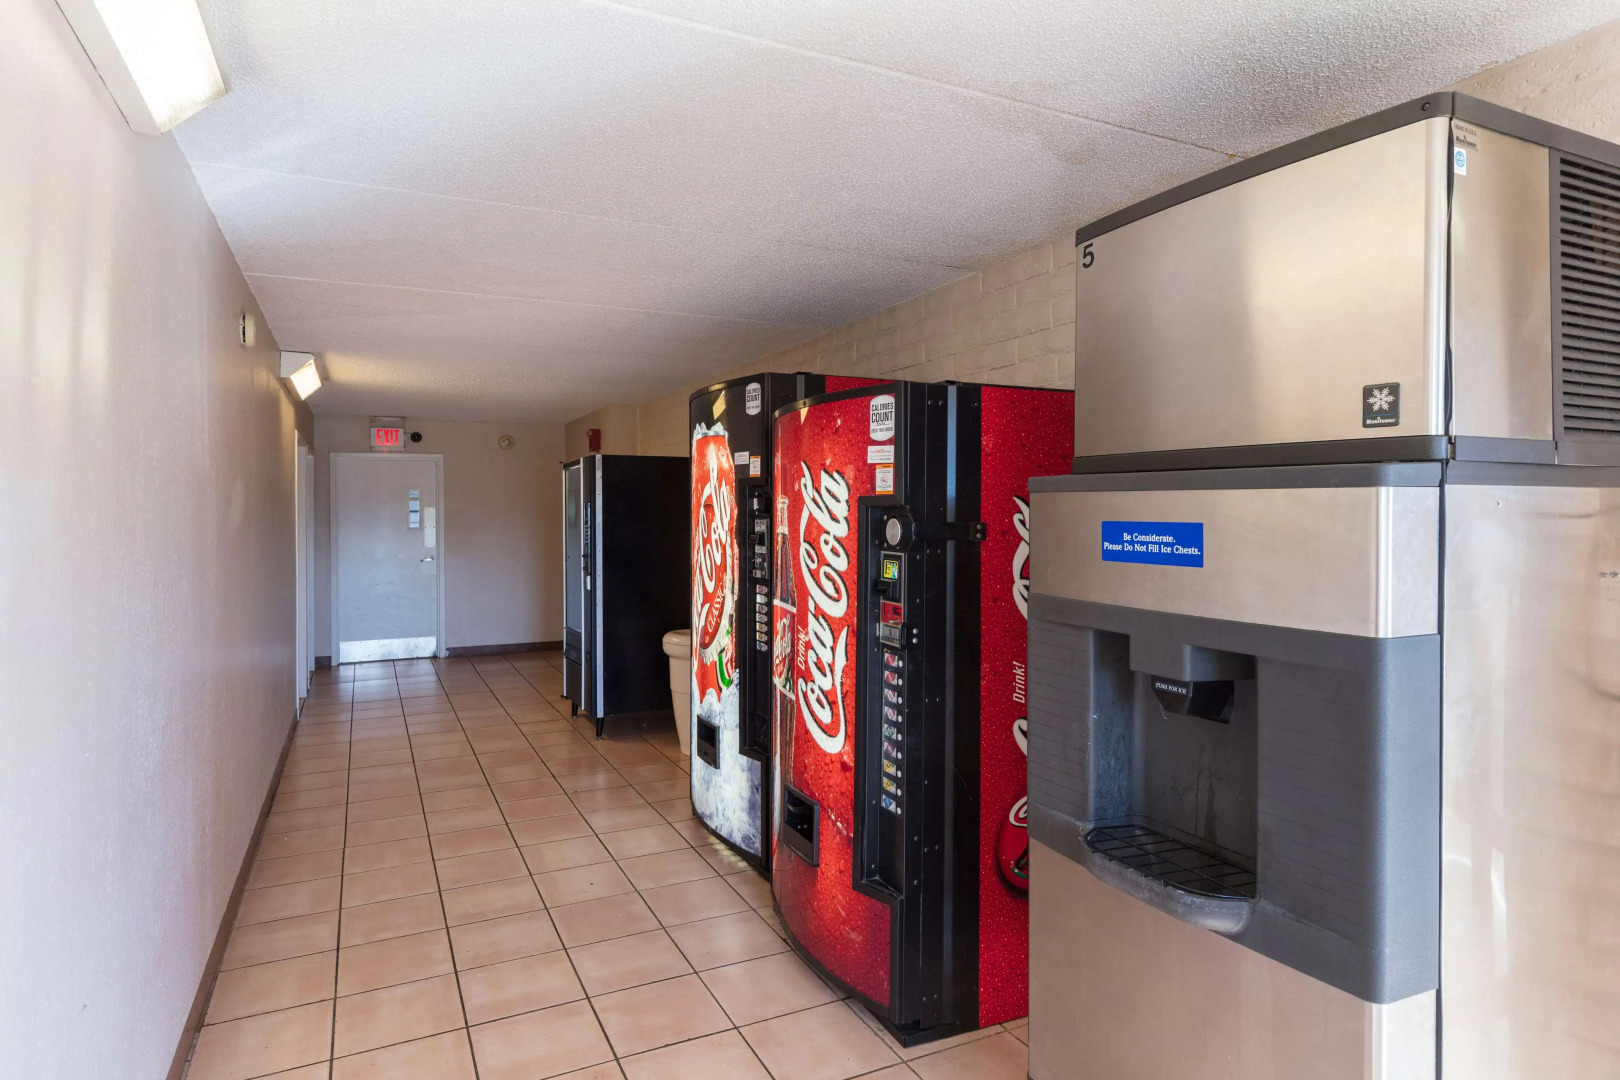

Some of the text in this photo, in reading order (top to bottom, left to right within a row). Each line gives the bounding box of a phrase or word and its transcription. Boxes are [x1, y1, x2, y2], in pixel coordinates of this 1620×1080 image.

[1082, 242, 1095, 269] 5
[747, 394, 760, 402] COUNT
[871, 402, 894, 412] CALORIES
[871, 411, 894, 423] COUNT
[375, 428, 400, 447] EXIT
[1123, 532, 1176, 543] Be Considerate.
[1103, 542, 1201, 555] Please Do Not Fill Ice Chests.
[797, 626, 806, 671] Drink!
[1012, 660, 1026, 704] Drink!
[1155, 682, 1168, 690] PUSH
